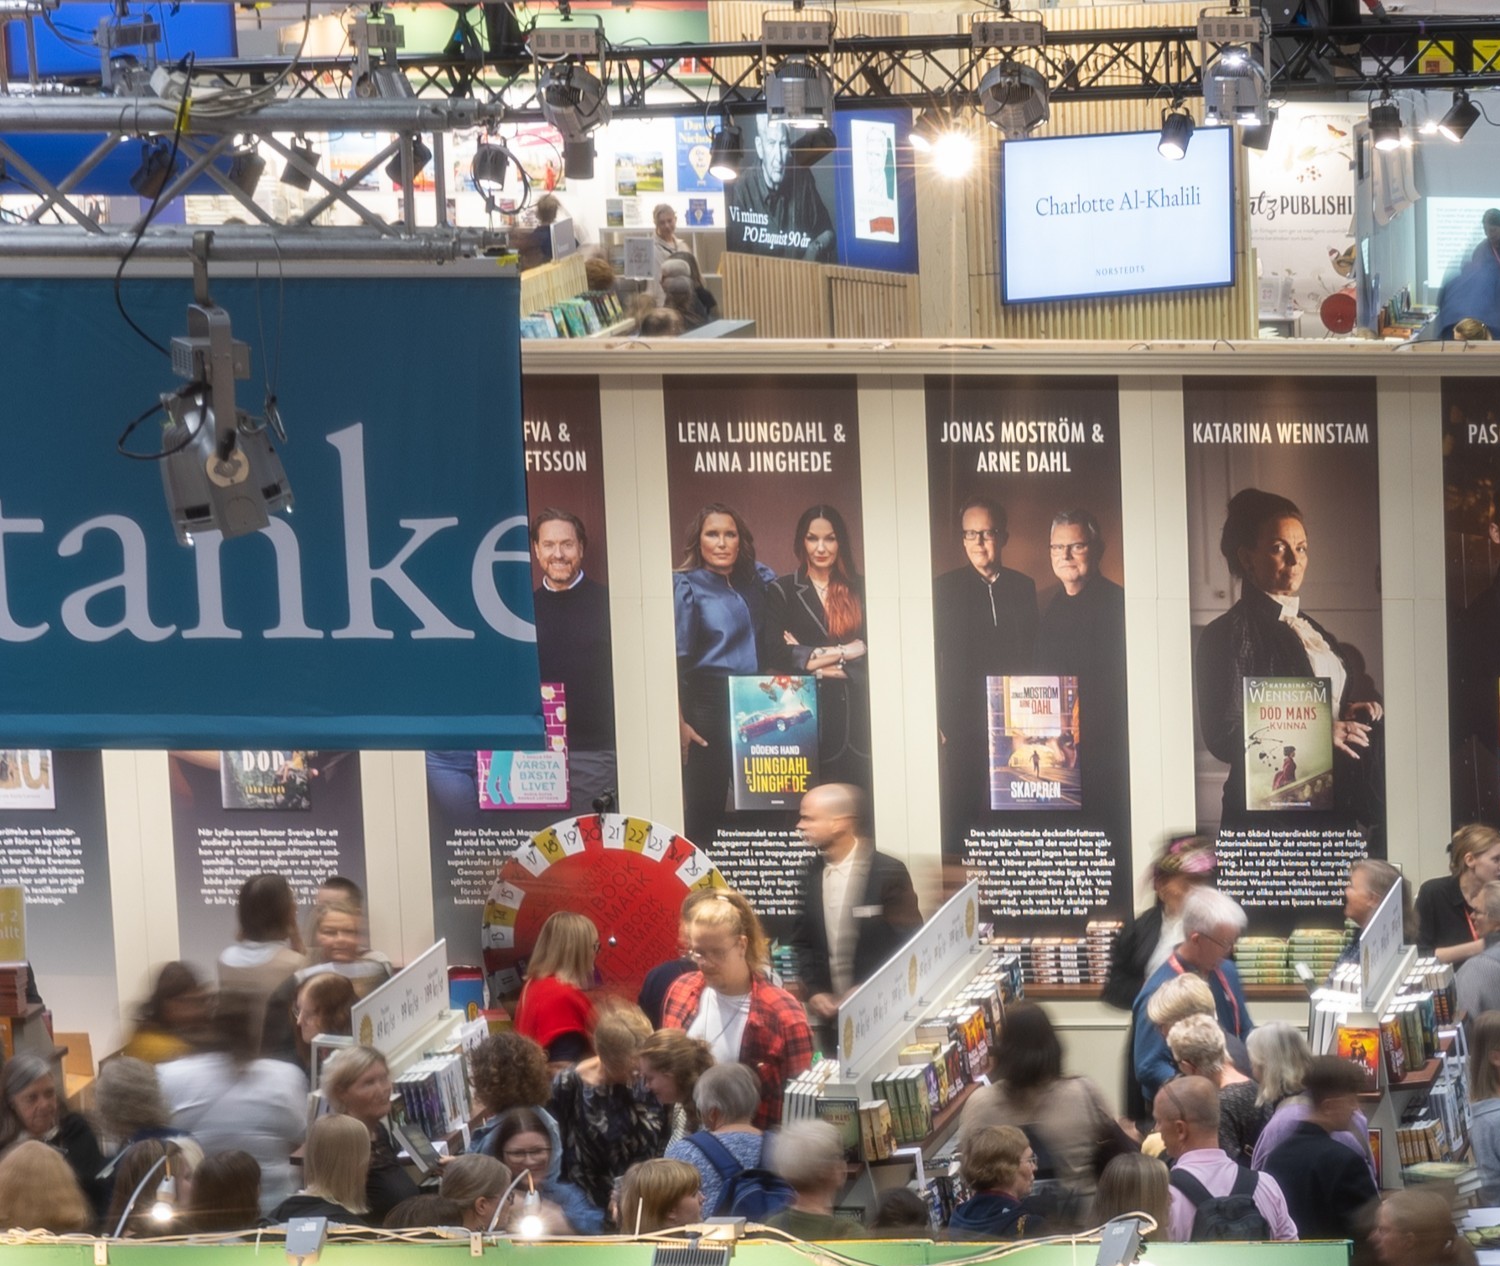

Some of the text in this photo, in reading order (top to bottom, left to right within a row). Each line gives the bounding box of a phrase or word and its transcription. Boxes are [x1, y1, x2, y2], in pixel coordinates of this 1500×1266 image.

[1036, 186, 1201, 217] Charlotte Al-Khalili
[729, 206, 769, 225] Vi minns
[743, 226, 758, 242] PO
[788, 232, 802, 247] 90
[1096, 265, 1146, 277] NORSTEDTS
[678, 422, 846, 444] LENA LJUNGDAHL &
[940, 416, 1105, 444] JONAS MOSTRÖM &
[1192, 422, 1370, 445] KATARINA WENNSTAM
[694, 450, 833, 473] ANNA JINGHEDE
[976, 450, 1072, 473] ARNE DAHL
[1250, 686, 1327, 703] WENNSTAM
[1260, 706, 1317, 720] DÖD MANS
[1270, 722, 1307, 730] KVINNA
[750, 744, 800, 756] DÖDENS HAND
[516, 760, 561, 770] VÄRSTA
[520, 770, 558, 781] BÄSTA
[522, 781, 555, 792] LIVET
[749, 775, 808, 793] JINGHEDE
[1010, 781, 1061, 799] SKAPAREN
[260, 828, 285, 838] lämnar
[287, 828, 314, 838] Sverige
[563, 831, 577, 846] 19
[608, 826, 621, 841] 21
[628, 824, 645, 843] 22
[970, 829, 1105, 838] Den världsberömda deckarförfattaren
[1220, 829, 1362, 838] När en ökänd teaterdirektör störtar från
[965, 839, 979, 849] Tom
[981, 839, 998, 849] Borg
[1216, 839, 1321, 849] Katarinahissen blir det starten
[739, 859, 757, 867] Nikki
